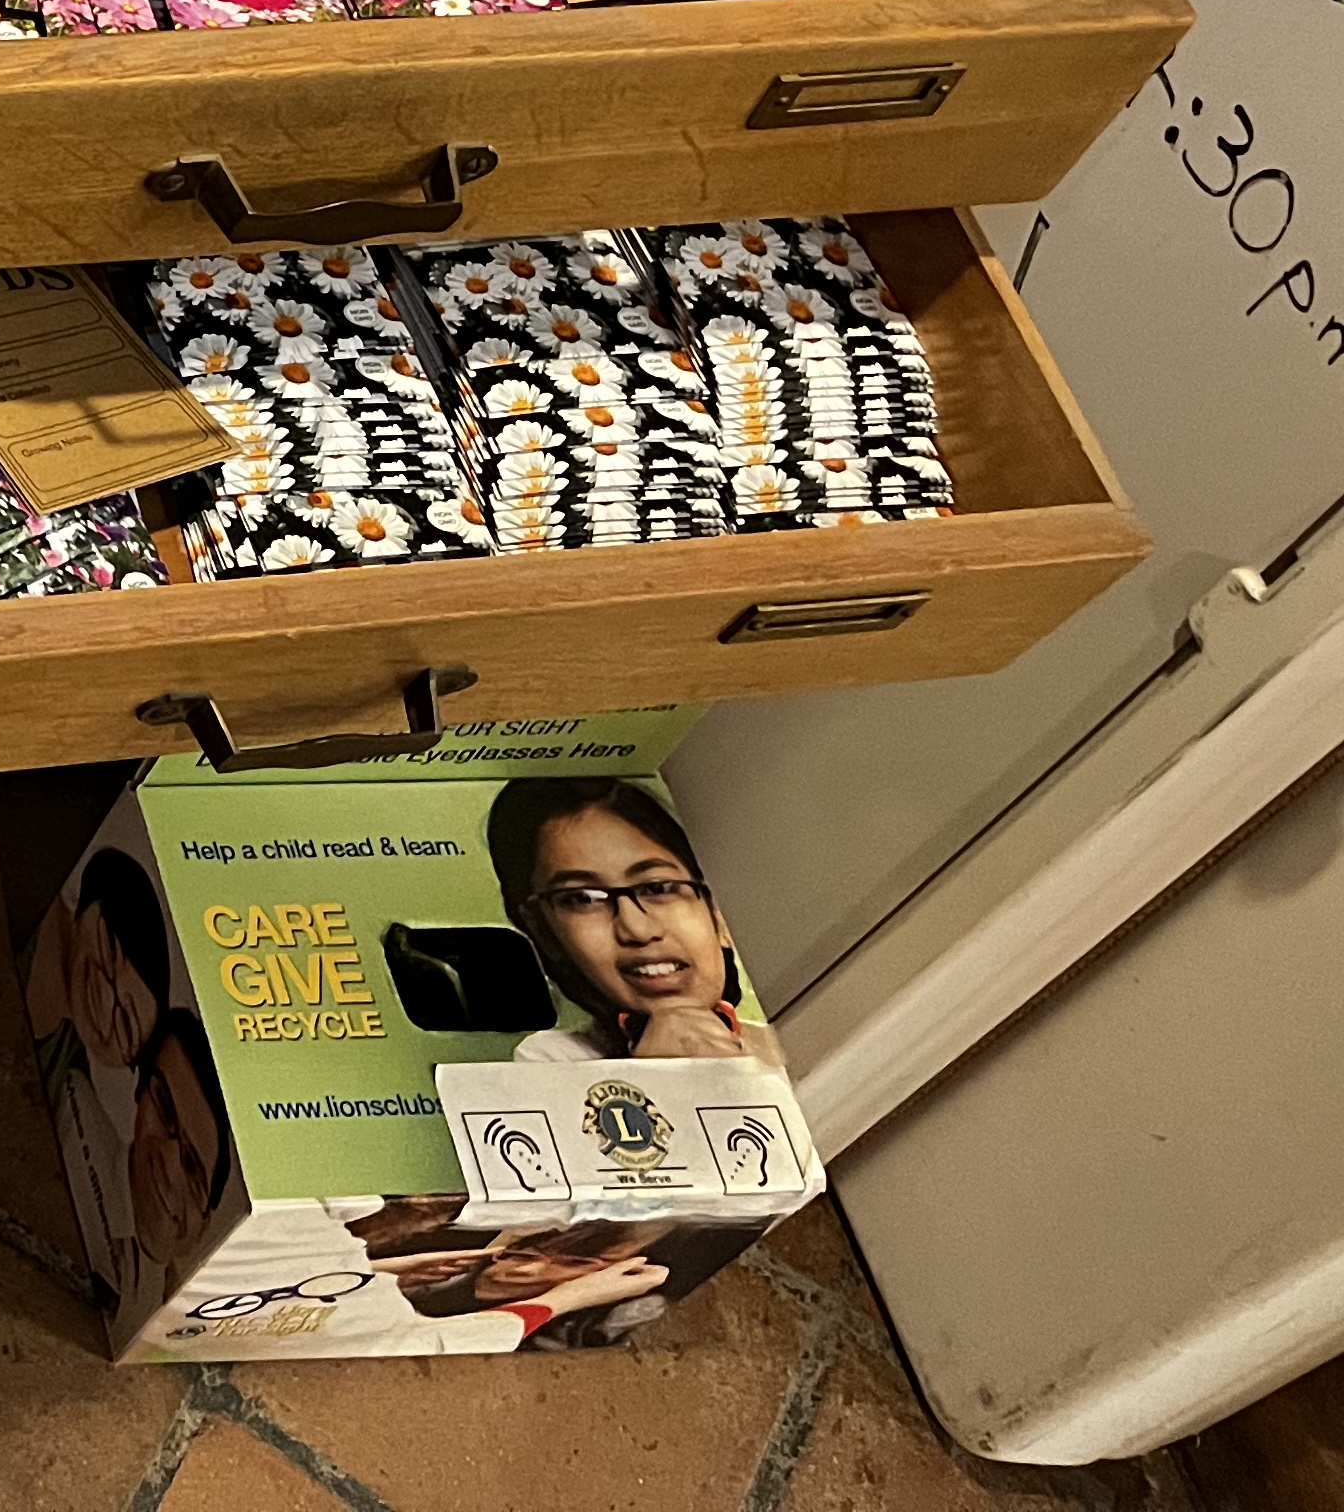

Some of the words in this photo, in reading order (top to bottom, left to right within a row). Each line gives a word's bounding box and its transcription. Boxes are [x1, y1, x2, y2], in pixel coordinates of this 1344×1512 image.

[500, 719, 584, 736] SIGHT
[566, 742, 636, 759] Here
[182, 840, 235, 864] Help
[243, 844, 256, 859] a
[262, 838, 317, 859] child
[323, 837, 373, 857] read
[381, 837, 397, 857] &
[403, 836, 464, 857] learn.
[203, 904, 356, 949] CARE
[220, 953, 374, 1008] GIVE
[235, 1011, 386, 1042] RECYCLE
[593, 1086, 641, 1102] LIONS
[610, 1108, 643, 1142] L
